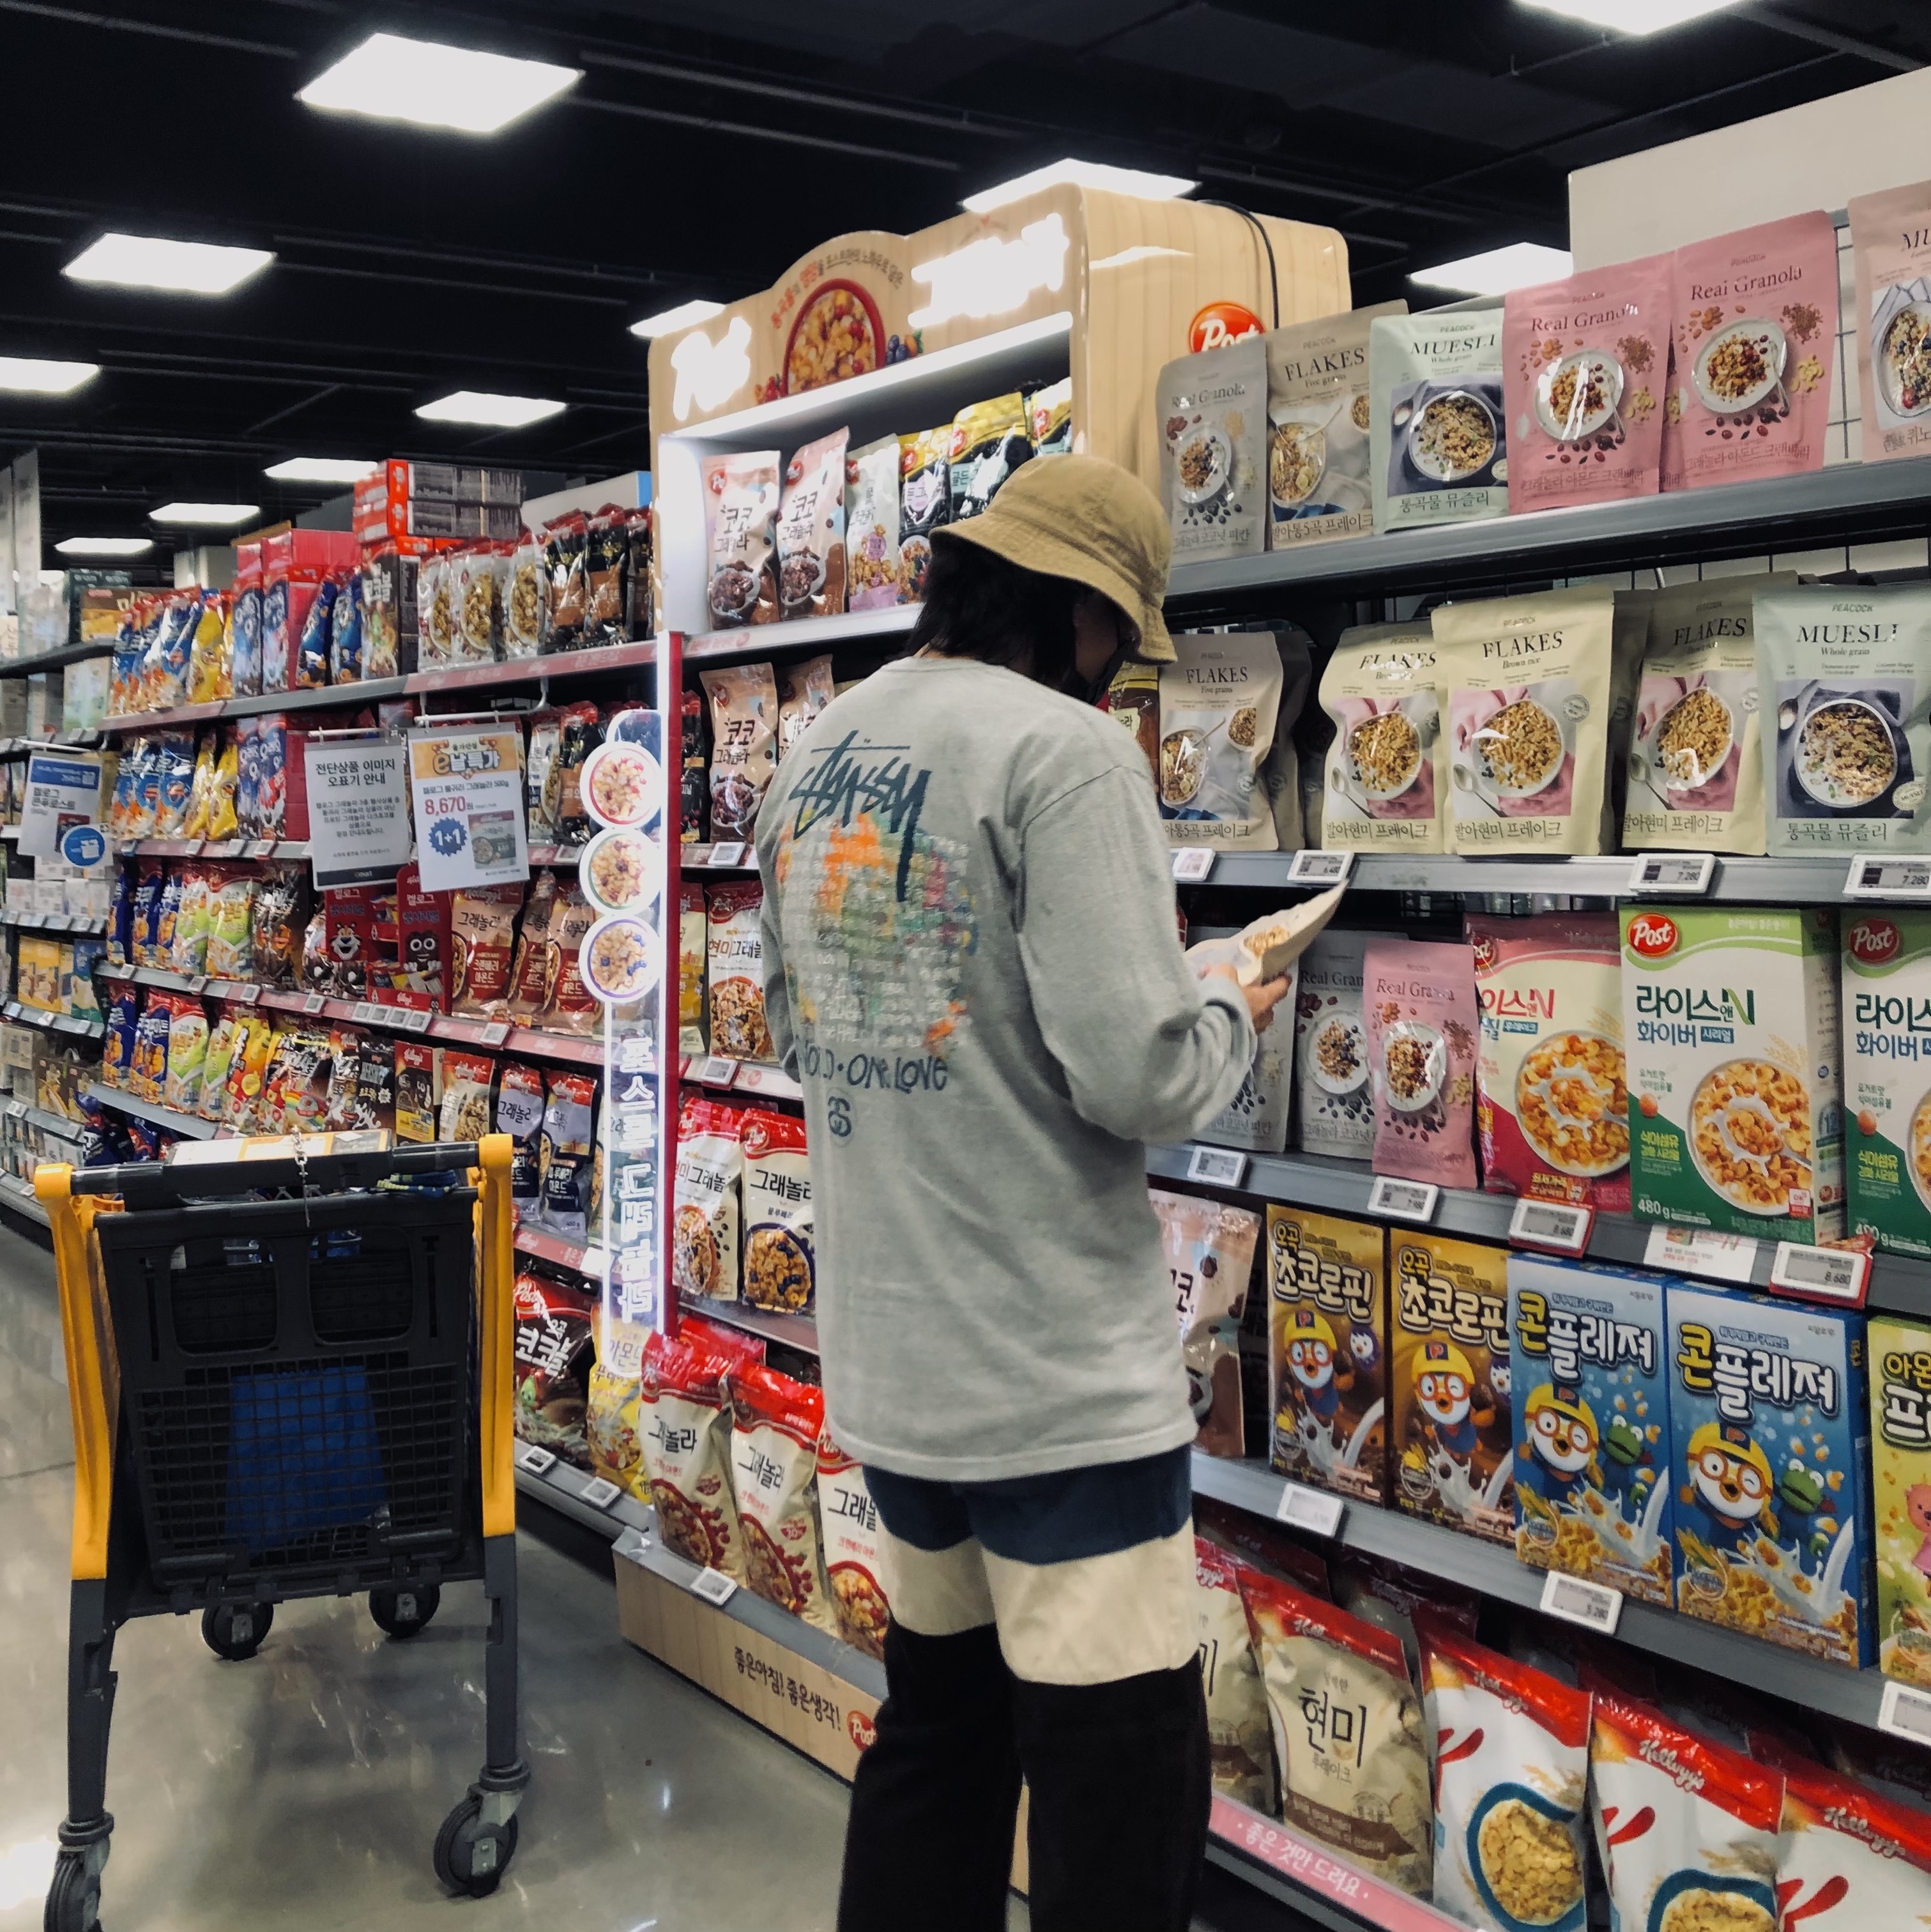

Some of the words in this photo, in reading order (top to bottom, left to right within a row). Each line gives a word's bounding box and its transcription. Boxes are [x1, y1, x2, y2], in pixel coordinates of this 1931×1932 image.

[1691, 280, 1729, 301] Real
[1734, 265, 1803, 293] Granola
[1531, 314, 1569, 332] Real
[1573, 303, 1639, 328] Grano
[1410, 334, 1495, 355] MUESLI
[1284, 348, 1366, 381] FLAKES
[1400, 494, 1442, 514] 통곡물
[1446, 491, 1490, 511] 뮤즐리
[1325, 513, 1373, 533] 프레이크
[1674, 617, 1748, 646] FLAKES
[1796, 623, 1899, 643] MUESLI
[1483, 631, 1564, 660] FLAKES
[1359, 652, 1437, 670] FLAKES
[1185, 666, 1249, 684] FLAKES
[1200, 686, 1214, 694] Five
[1215, 686, 1233, 696] grains
[316, 761, 360, 776] 전단상품
[362, 758, 396, 772] 이미지
[327, 774, 361, 787] 오표기
[363, 772, 386, 786] 안내
[1164, 824, 1200, 838] 아통5곡
[1203, 823, 1251, 838] 프레이크
[1326, 823, 1373, 839] 발아현미
[1375, 824, 1429, 839] 프레이크
[1454, 823, 1504, 840] 발아현미
[1507, 821, 1562, 839] 프레이크
[1671, 815, 1723, 834] 프레이크
[1788, 823, 1832, 840] 통곡물
[1837, 822, 1887, 842] 뮤즐리
[434, 828, 462, 847] 1+1
[406, 894, 435, 906] 켈로그
[1633, 922, 1672, 947] Post
[1853, 925, 1895, 953] Post
[708, 939, 762, 960] 현미그래놀
[1301, 969, 1328, 986] Real
[1331, 971, 1364, 988] Gran
[1376, 978, 1406, 996] Real
[1637, 1019, 1697, 1048] 화이버
[1855, 1030, 1918, 1062] 화이버
[896, 1055, 949, 1094] LOVE
[675, 1160, 726, 1193] 미그래놀
[1637, 1198, 1661, 1215] 480
[1276, 1222, 1301, 1251] 오곡
[1401, 1250, 1432, 1281] 오곡
[1276, 1248, 1372, 1320] 초코로핀
[1516, 1291, 1652, 1379] 콘플레져
[1677, 1323, 1835, 1419] 콘플레져
[827, 1487, 877, 1532] 그래놀
[851, 1719, 877, 1747] Post
[1298, 1687, 1367, 1769] 현미
[1244, 1823, 1278, 1853] 좋은
[1279, 1841, 1313, 1871] 것만
[1313, 1858, 1359, 1898] 드려요
